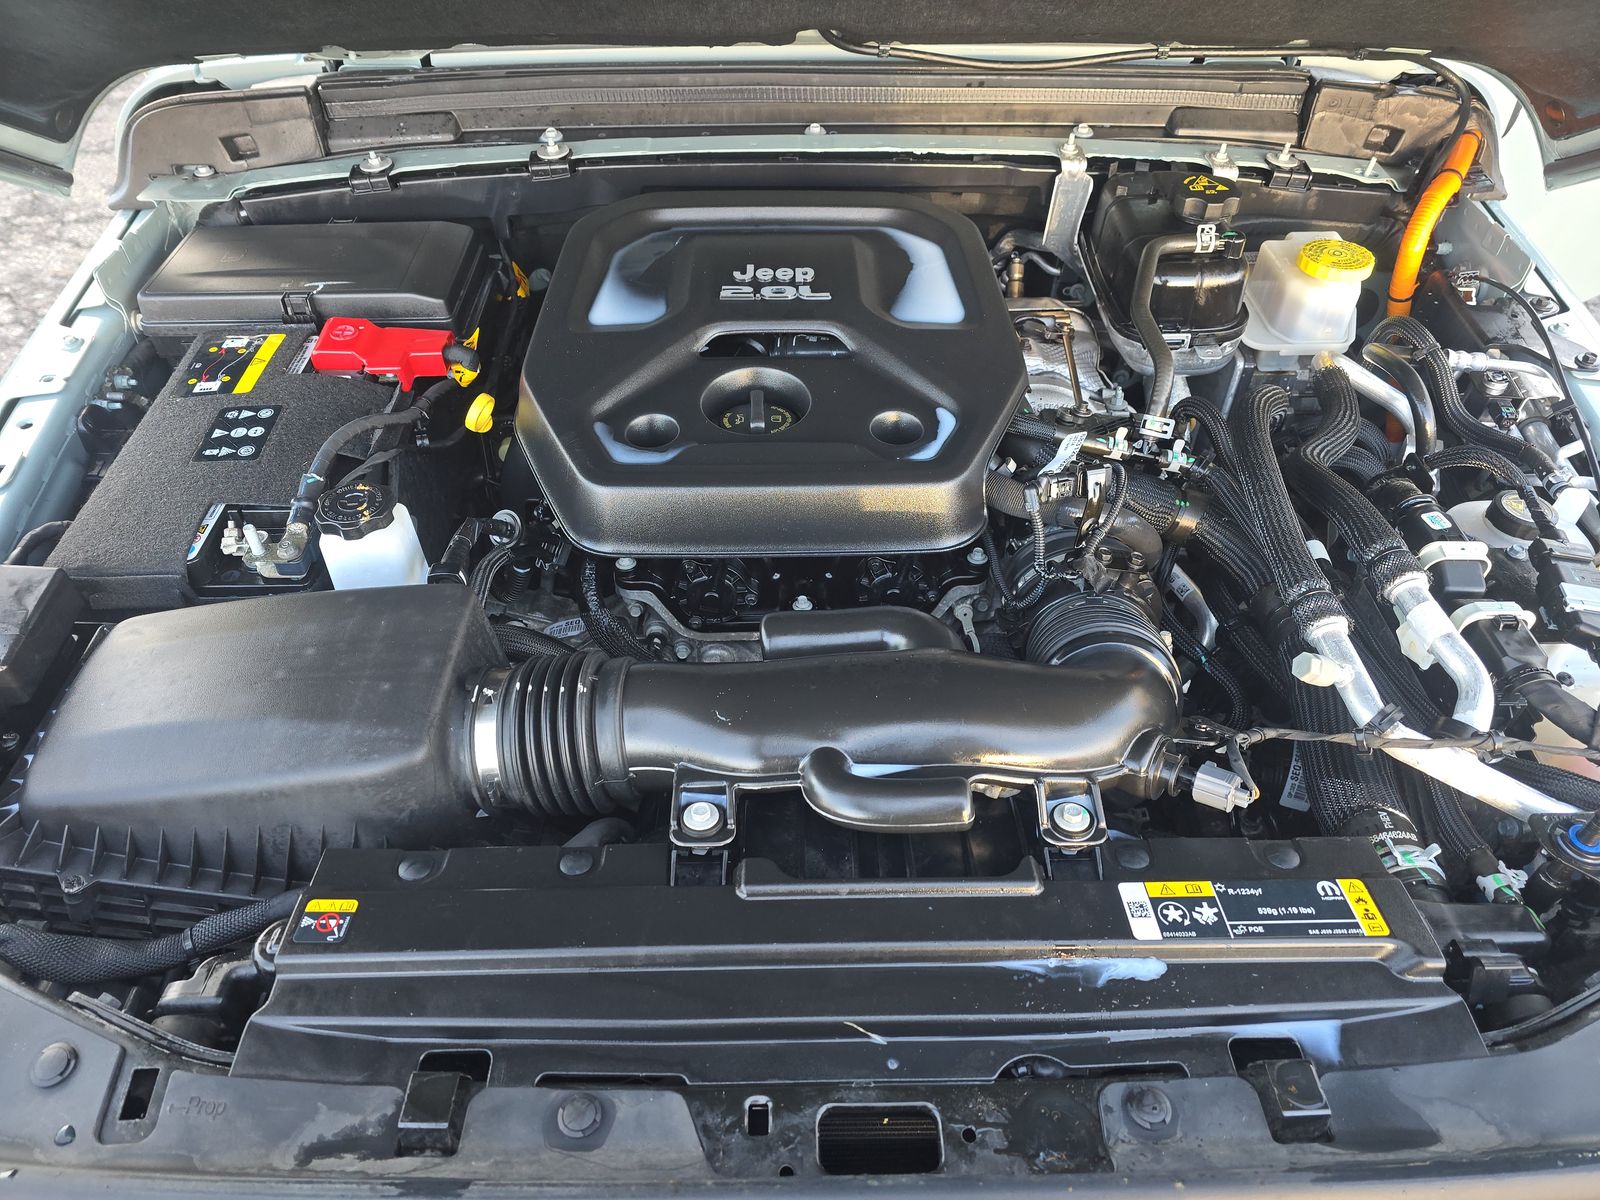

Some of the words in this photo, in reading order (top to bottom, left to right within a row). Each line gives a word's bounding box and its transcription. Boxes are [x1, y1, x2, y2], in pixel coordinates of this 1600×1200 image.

[733, 264, 815, 285] Jeep
[720, 285, 832, 300] 2.0L
[1378, 811, 1394, 829] PHEV
[1227, 887, 1263, 896] R-1234yf
[1299, 906, 1316, 915] lbs)
[186, 1096, 227, 1120] Prop
